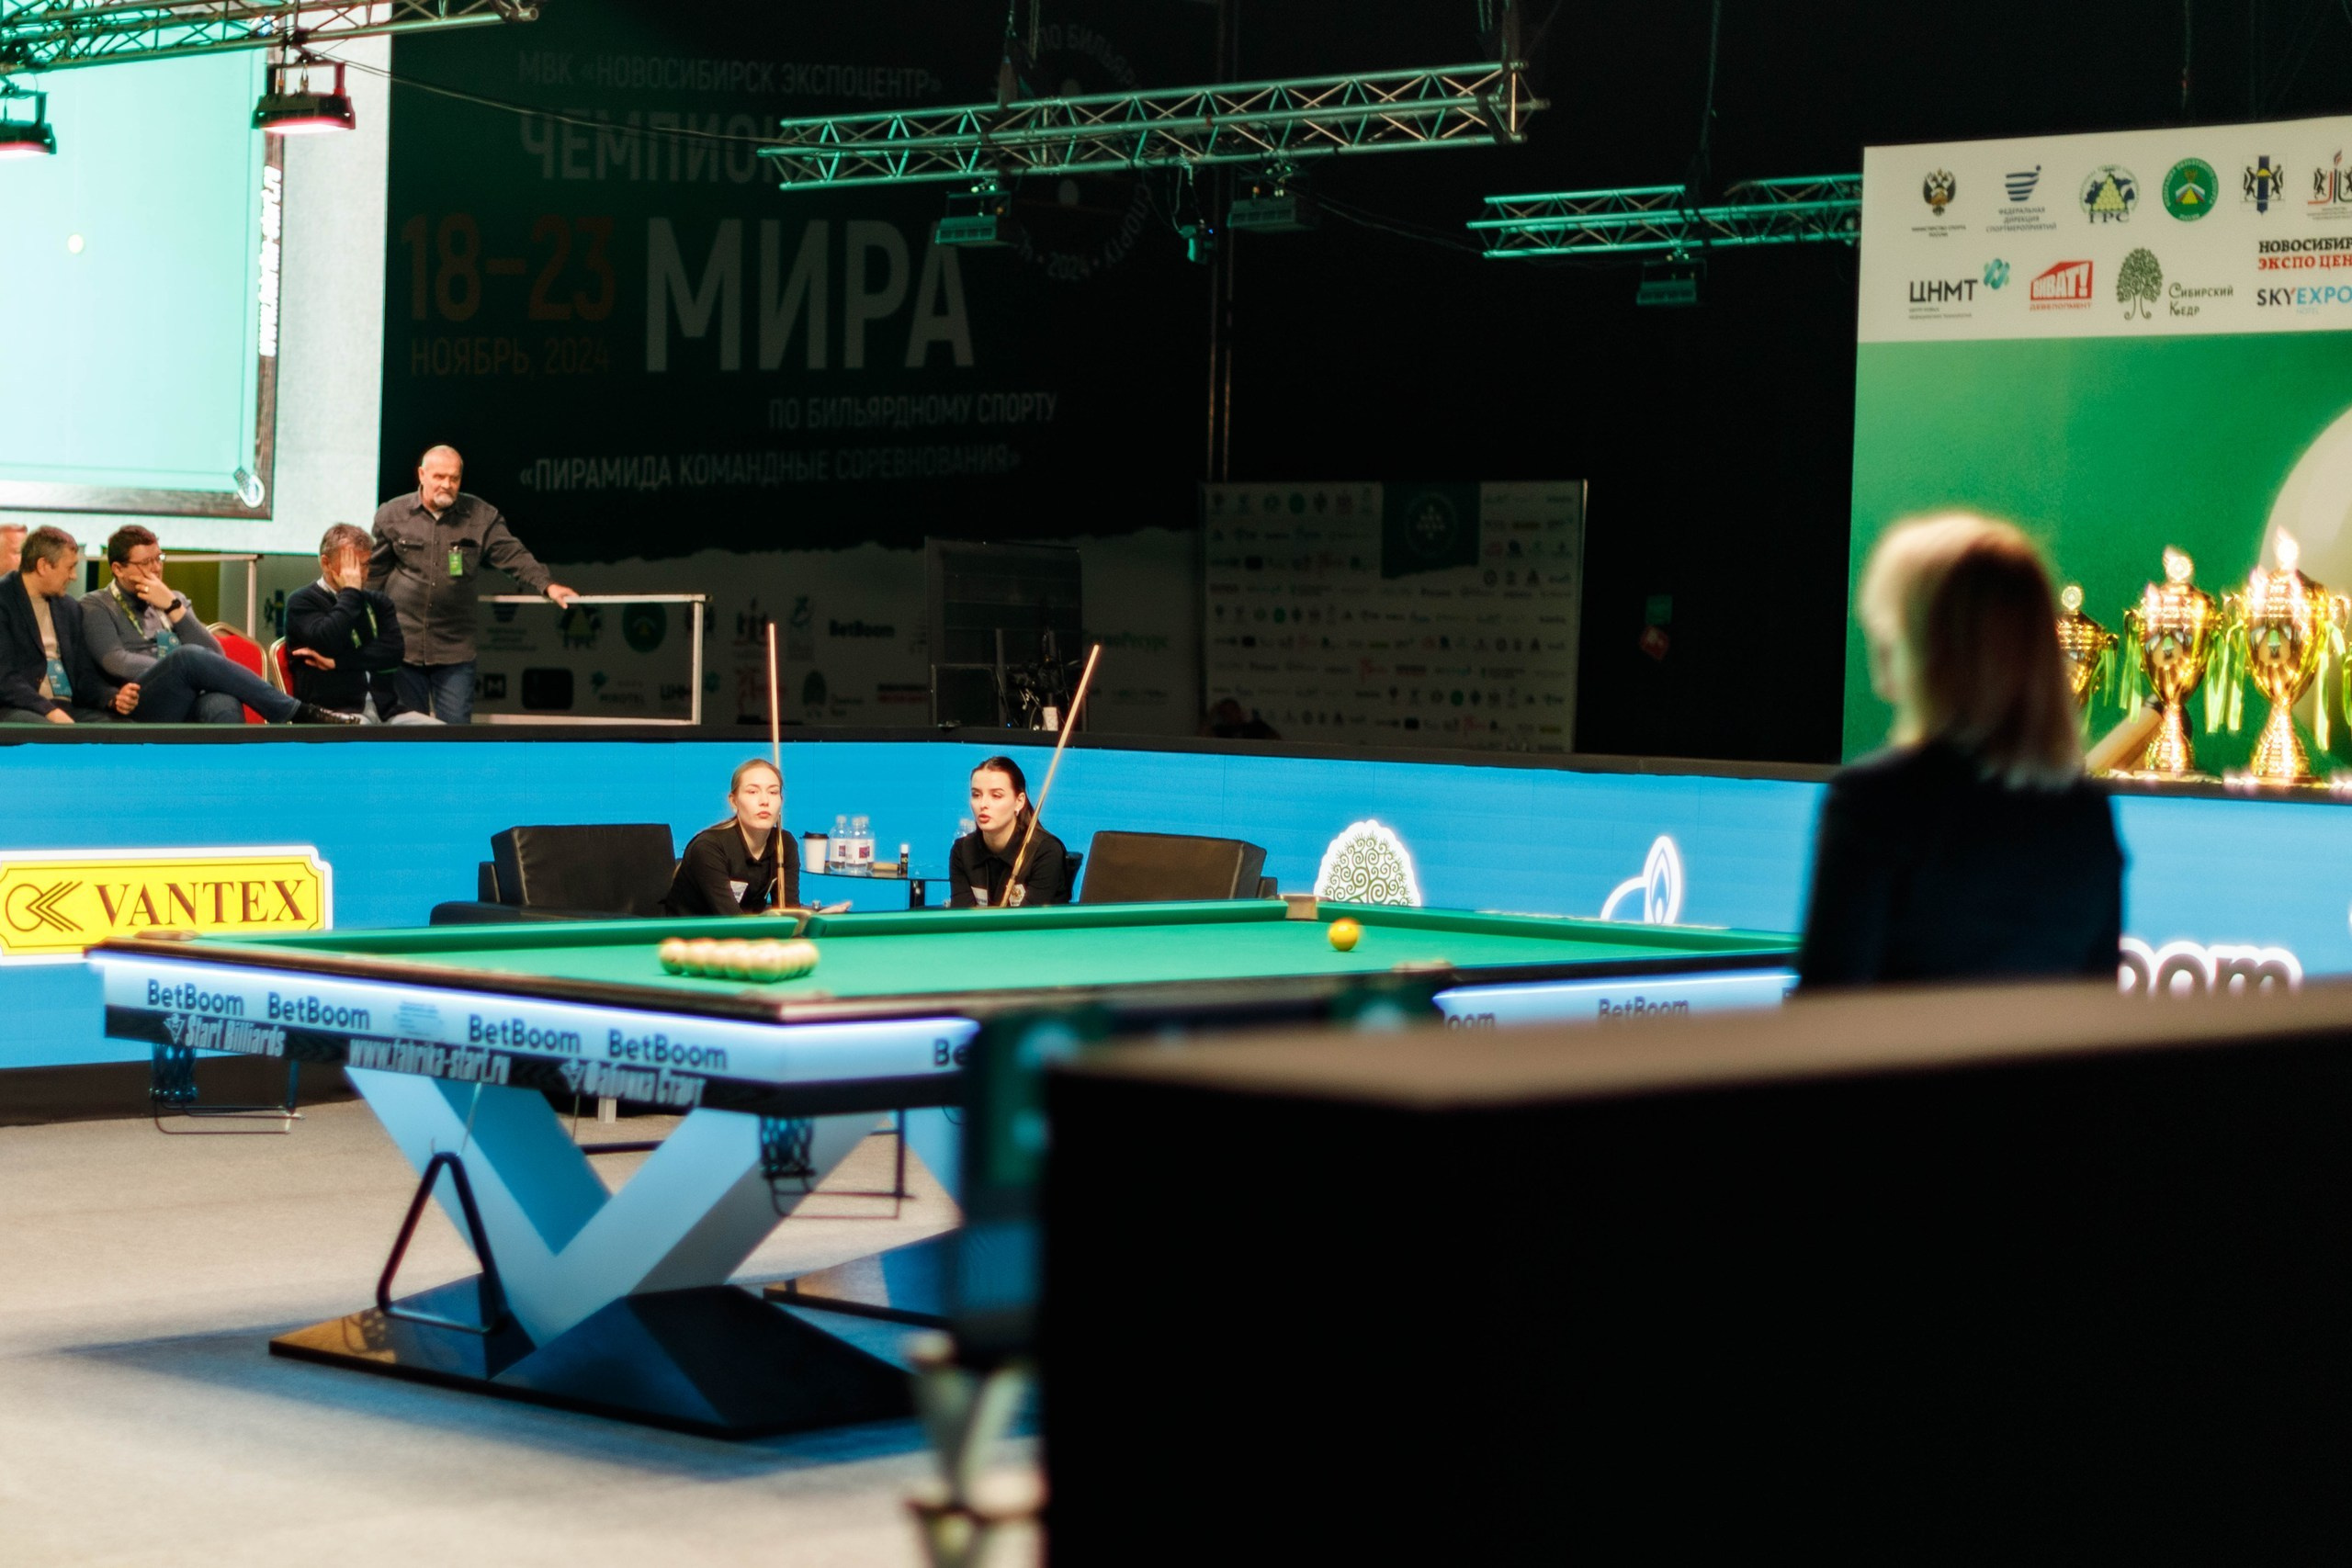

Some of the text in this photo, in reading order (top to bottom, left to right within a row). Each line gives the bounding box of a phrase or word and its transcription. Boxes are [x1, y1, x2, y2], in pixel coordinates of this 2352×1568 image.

[580, 56, 774, 93] «НОВОСИБИРСК
[782, 62, 943, 98] ЭКСПОЦЕНТР»
[2258, 237, 2352, 254] НОВОСИБИР
[647, 216, 975, 372] МИРА
[1909, 278, 1978, 303] ЦНМТ
[544, 336, 611, 375] 2024
[768, 392, 1058, 431] ПО БИЛЬЯРДНОМУ СПОРТУ
[520, 443, 1022, 492] «ПИРАМИДА КОМАНДНЫЕ СОРЕВНОВАНИЯ»
[96, 879, 308, 928] VANTEX
[147, 977, 245, 1017] BetBoom
[267, 991, 370, 1030] BetBoom
[185, 1013, 287, 1056] Start Billiards
[469, 1013, 582, 1054] BetBoom
[609, 1027, 728, 1070] BetBoom
